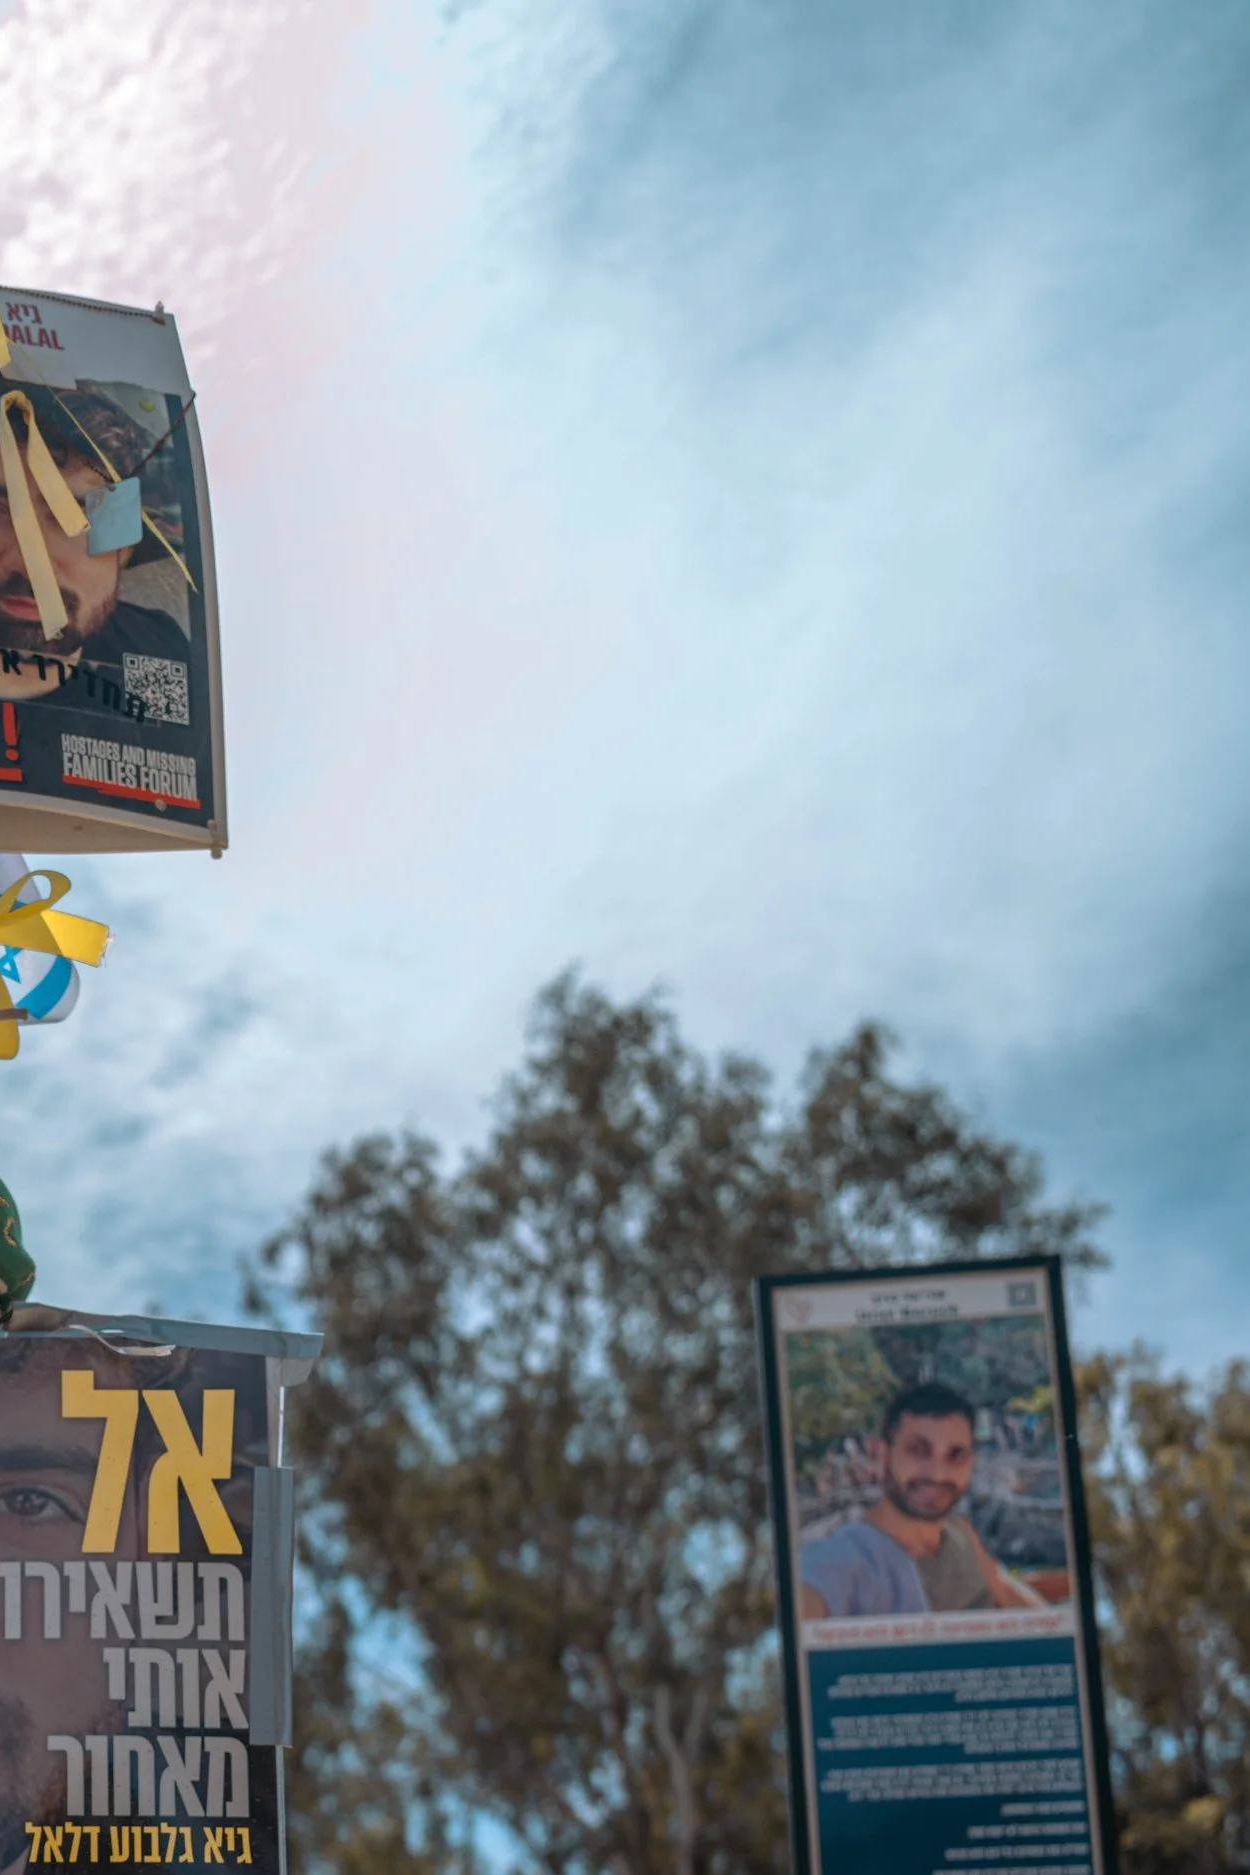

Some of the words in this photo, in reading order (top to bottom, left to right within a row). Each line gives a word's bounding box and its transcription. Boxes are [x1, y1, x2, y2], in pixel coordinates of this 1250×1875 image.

[7, 302, 42, 325] גיא
[61, 733, 121, 762] HOSTAGES
[122, 743, 145, 767] AND
[147, 749, 197, 777] MISSING
[63, 752, 138, 790] FAMILIES
[139, 766, 198, 802] FORUM
[60, 1368, 244, 1555] אל
[0, 1560, 245, 1641] תשאירו
[103, 1647, 250, 1730] אותי
[47, 1733, 251, 1819] מאחור
[24, 1821, 102, 1864] דלאל
[110, 1821, 195, 1864] גלבוע
[203, 1824, 254, 1866] גיא
